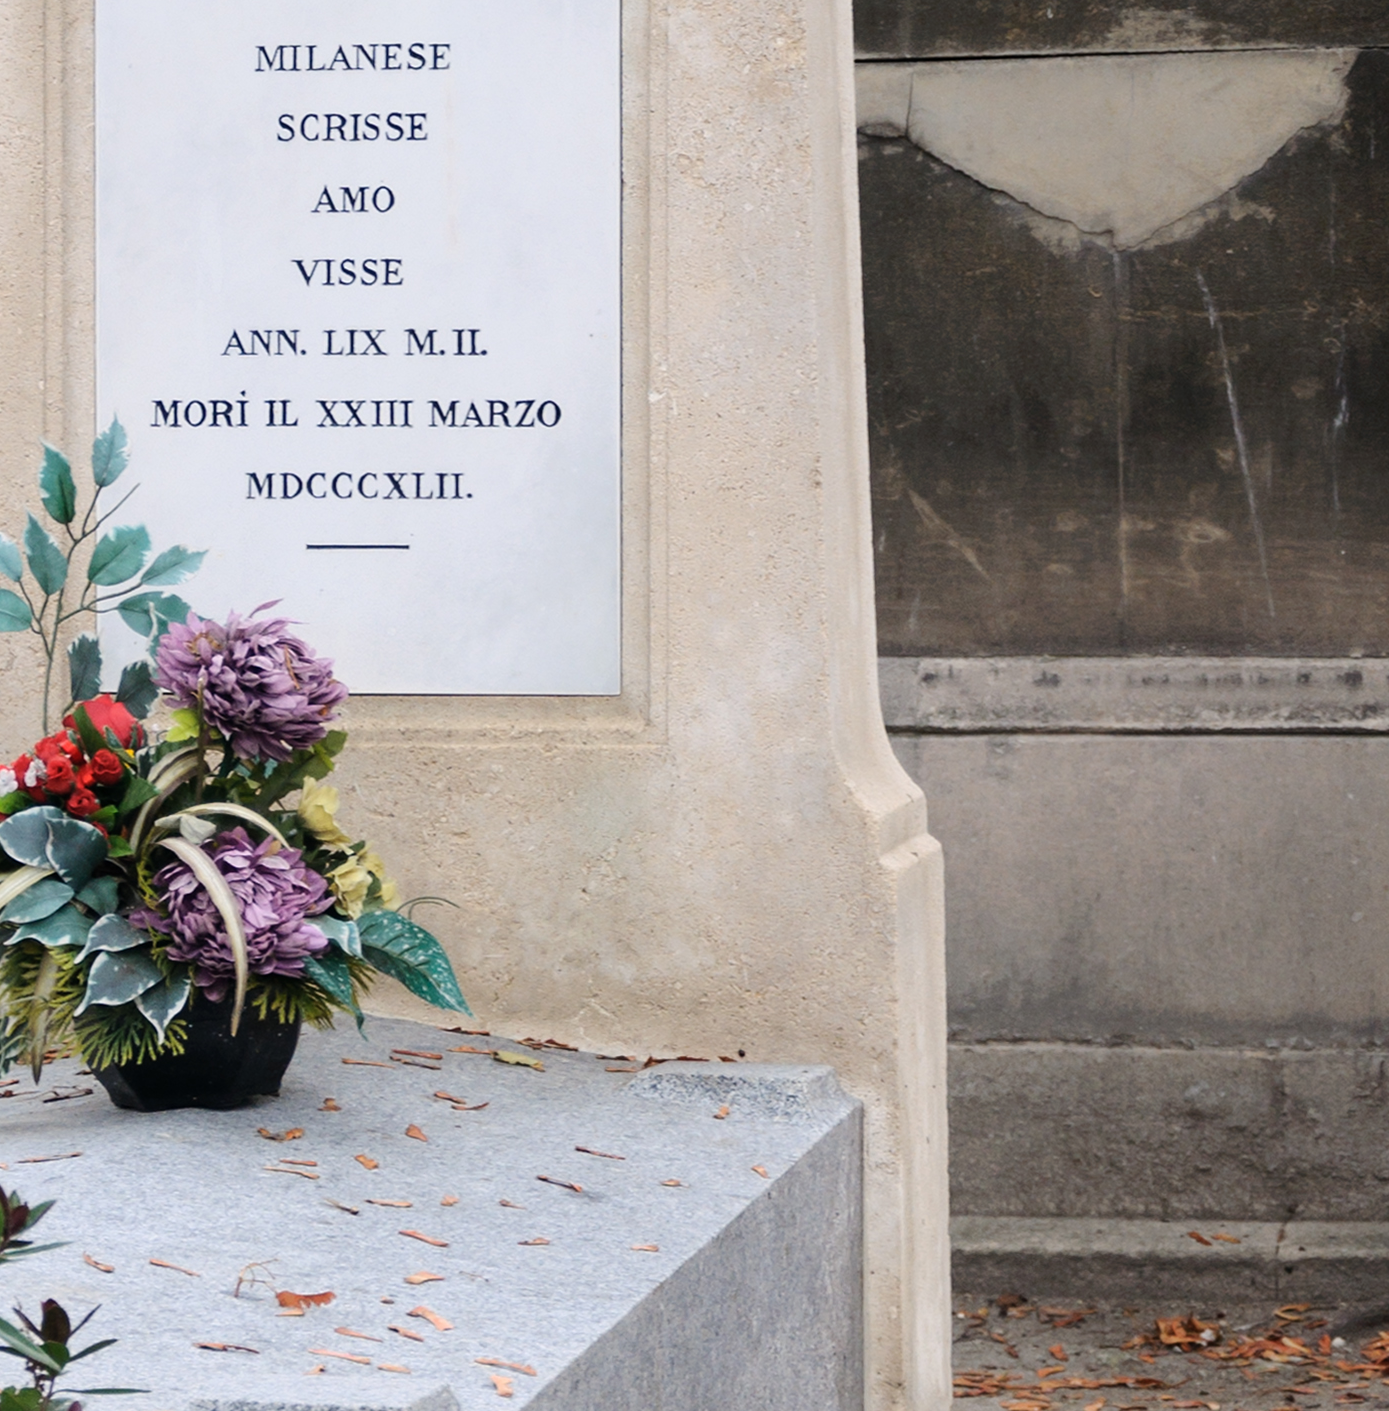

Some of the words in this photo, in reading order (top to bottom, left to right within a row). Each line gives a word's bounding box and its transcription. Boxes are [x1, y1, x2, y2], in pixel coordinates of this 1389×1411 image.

[255, 43, 450, 72] MILANESE
[277, 112, 427, 142] SCRISSE
[311, 186, 395, 213] AMO
[292, 259, 403, 286] VISSE
[222, 330, 306, 355] ANN.
[323, 330, 387, 355] LIX
[264, 400, 298, 426] IL
[316, 400, 413, 427] XXIII
[428, 400, 561, 427] MARZO
[246, 472, 472, 499] MDCCCXLII.
